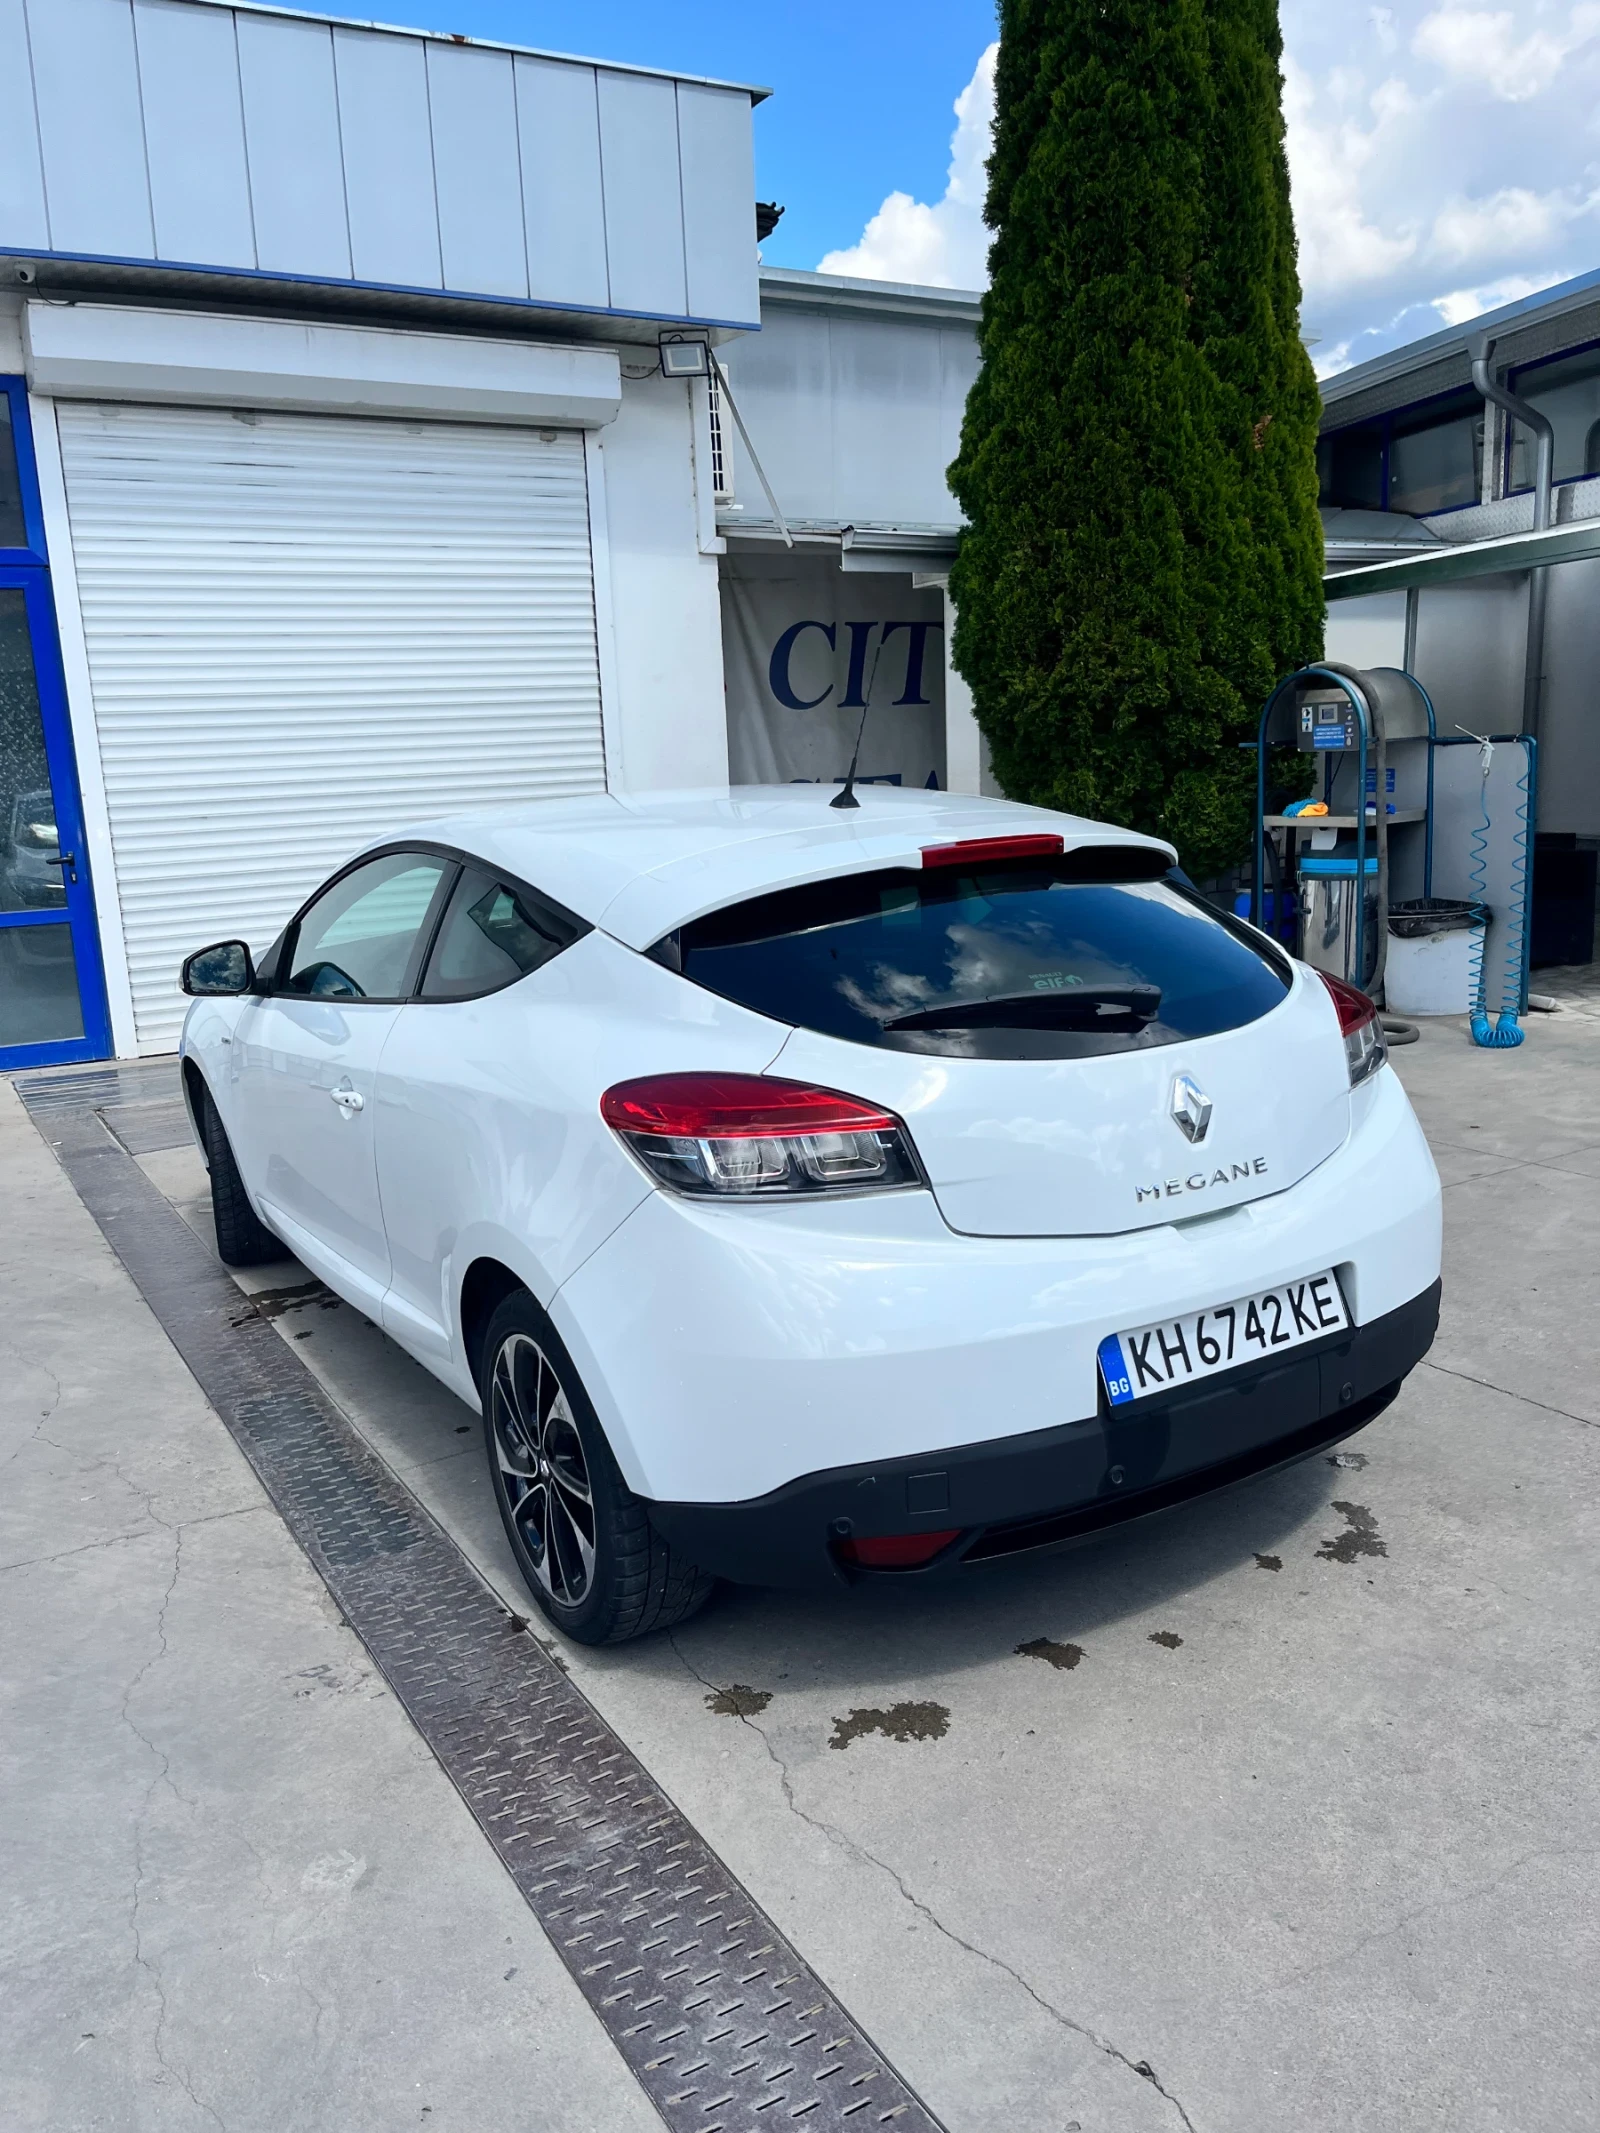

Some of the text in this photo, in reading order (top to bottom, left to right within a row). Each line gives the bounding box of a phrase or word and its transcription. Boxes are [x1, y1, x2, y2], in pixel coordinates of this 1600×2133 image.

[1034, 977, 1064, 990] elf
[1134, 1156, 1269, 1203] MEGANE
[1109, 1378, 1130, 1397] BG
